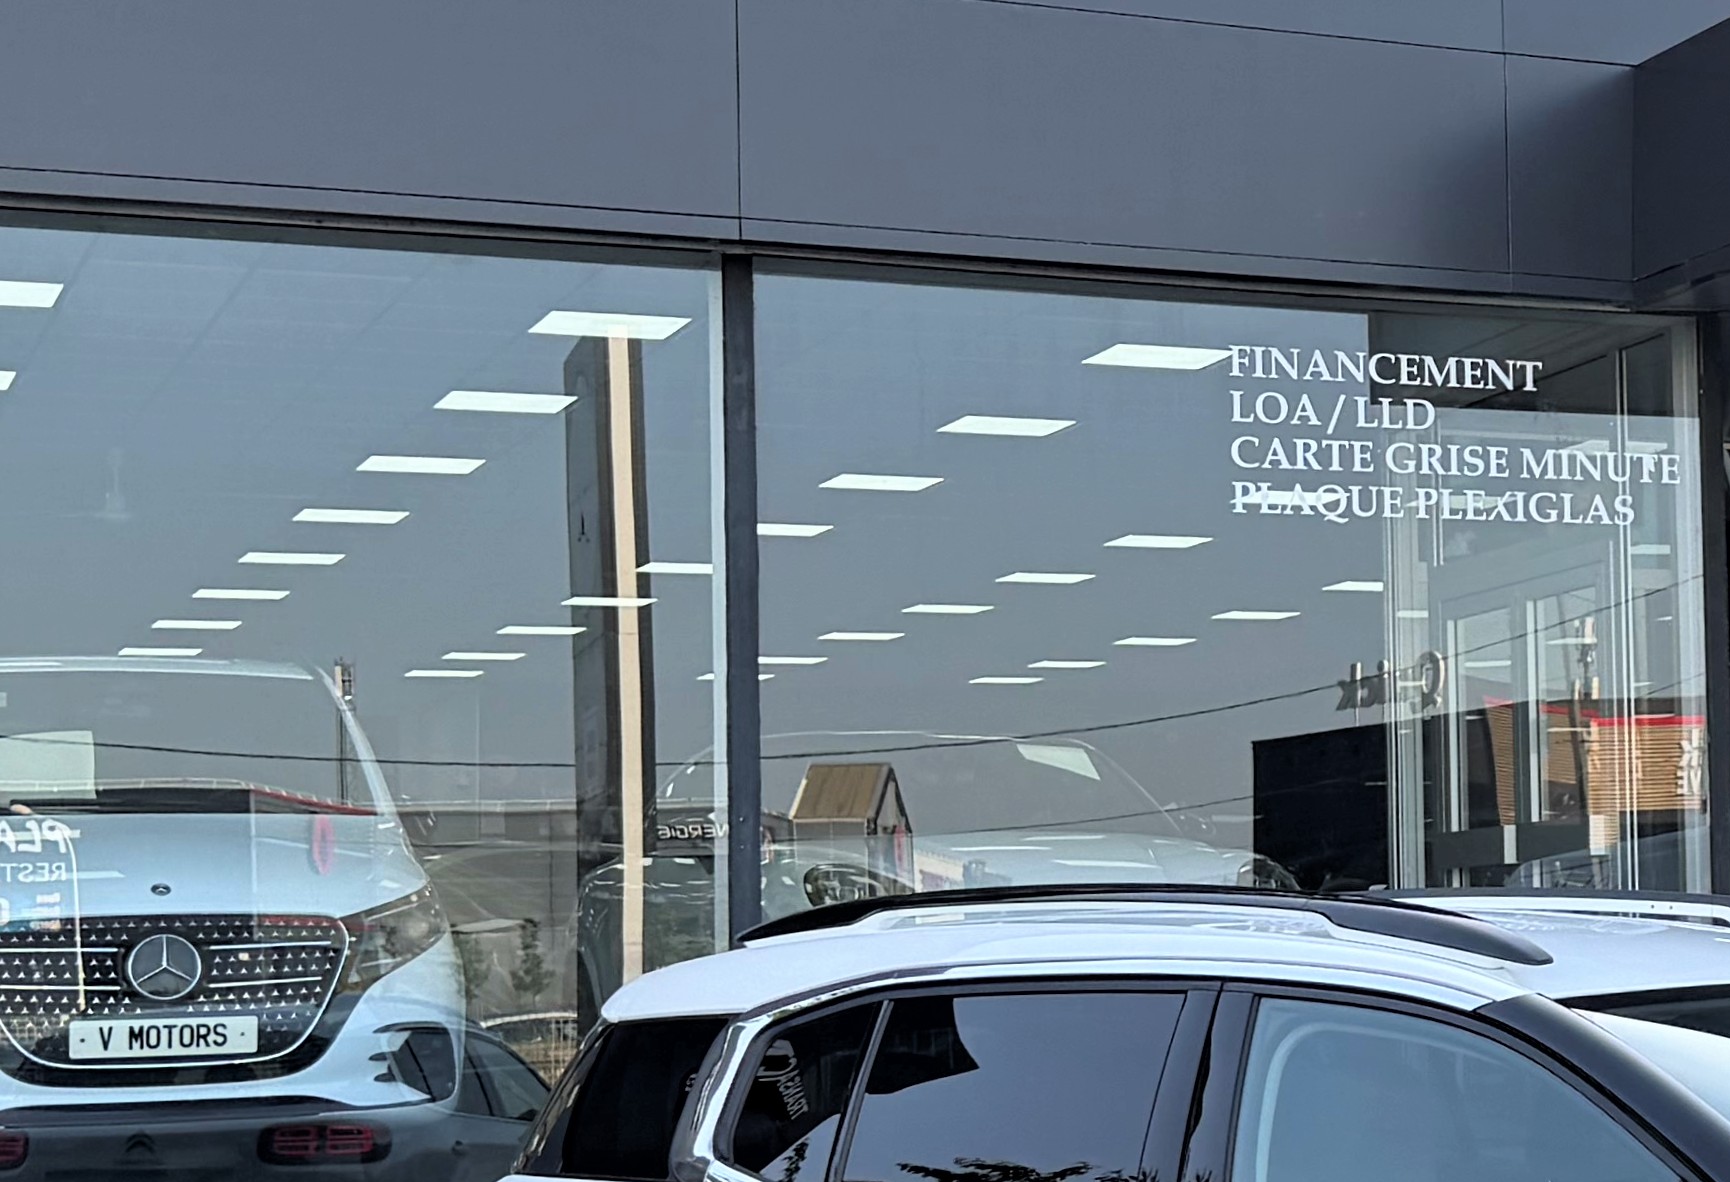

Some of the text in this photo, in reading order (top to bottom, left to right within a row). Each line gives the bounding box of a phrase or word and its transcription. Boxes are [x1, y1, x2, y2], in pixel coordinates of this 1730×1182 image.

[1228, 344, 1543, 392] FINANCEMENT
[1229, 389, 1322, 428] LOA
[1355, 395, 1436, 431] LLD
[1230, 436, 1682, 485] CARTE GRISE MINUTE
[1231, 480, 1636, 526] PLAQUE PLEXIGLAS
[99, 1022, 228, 1051] V MOTORS
